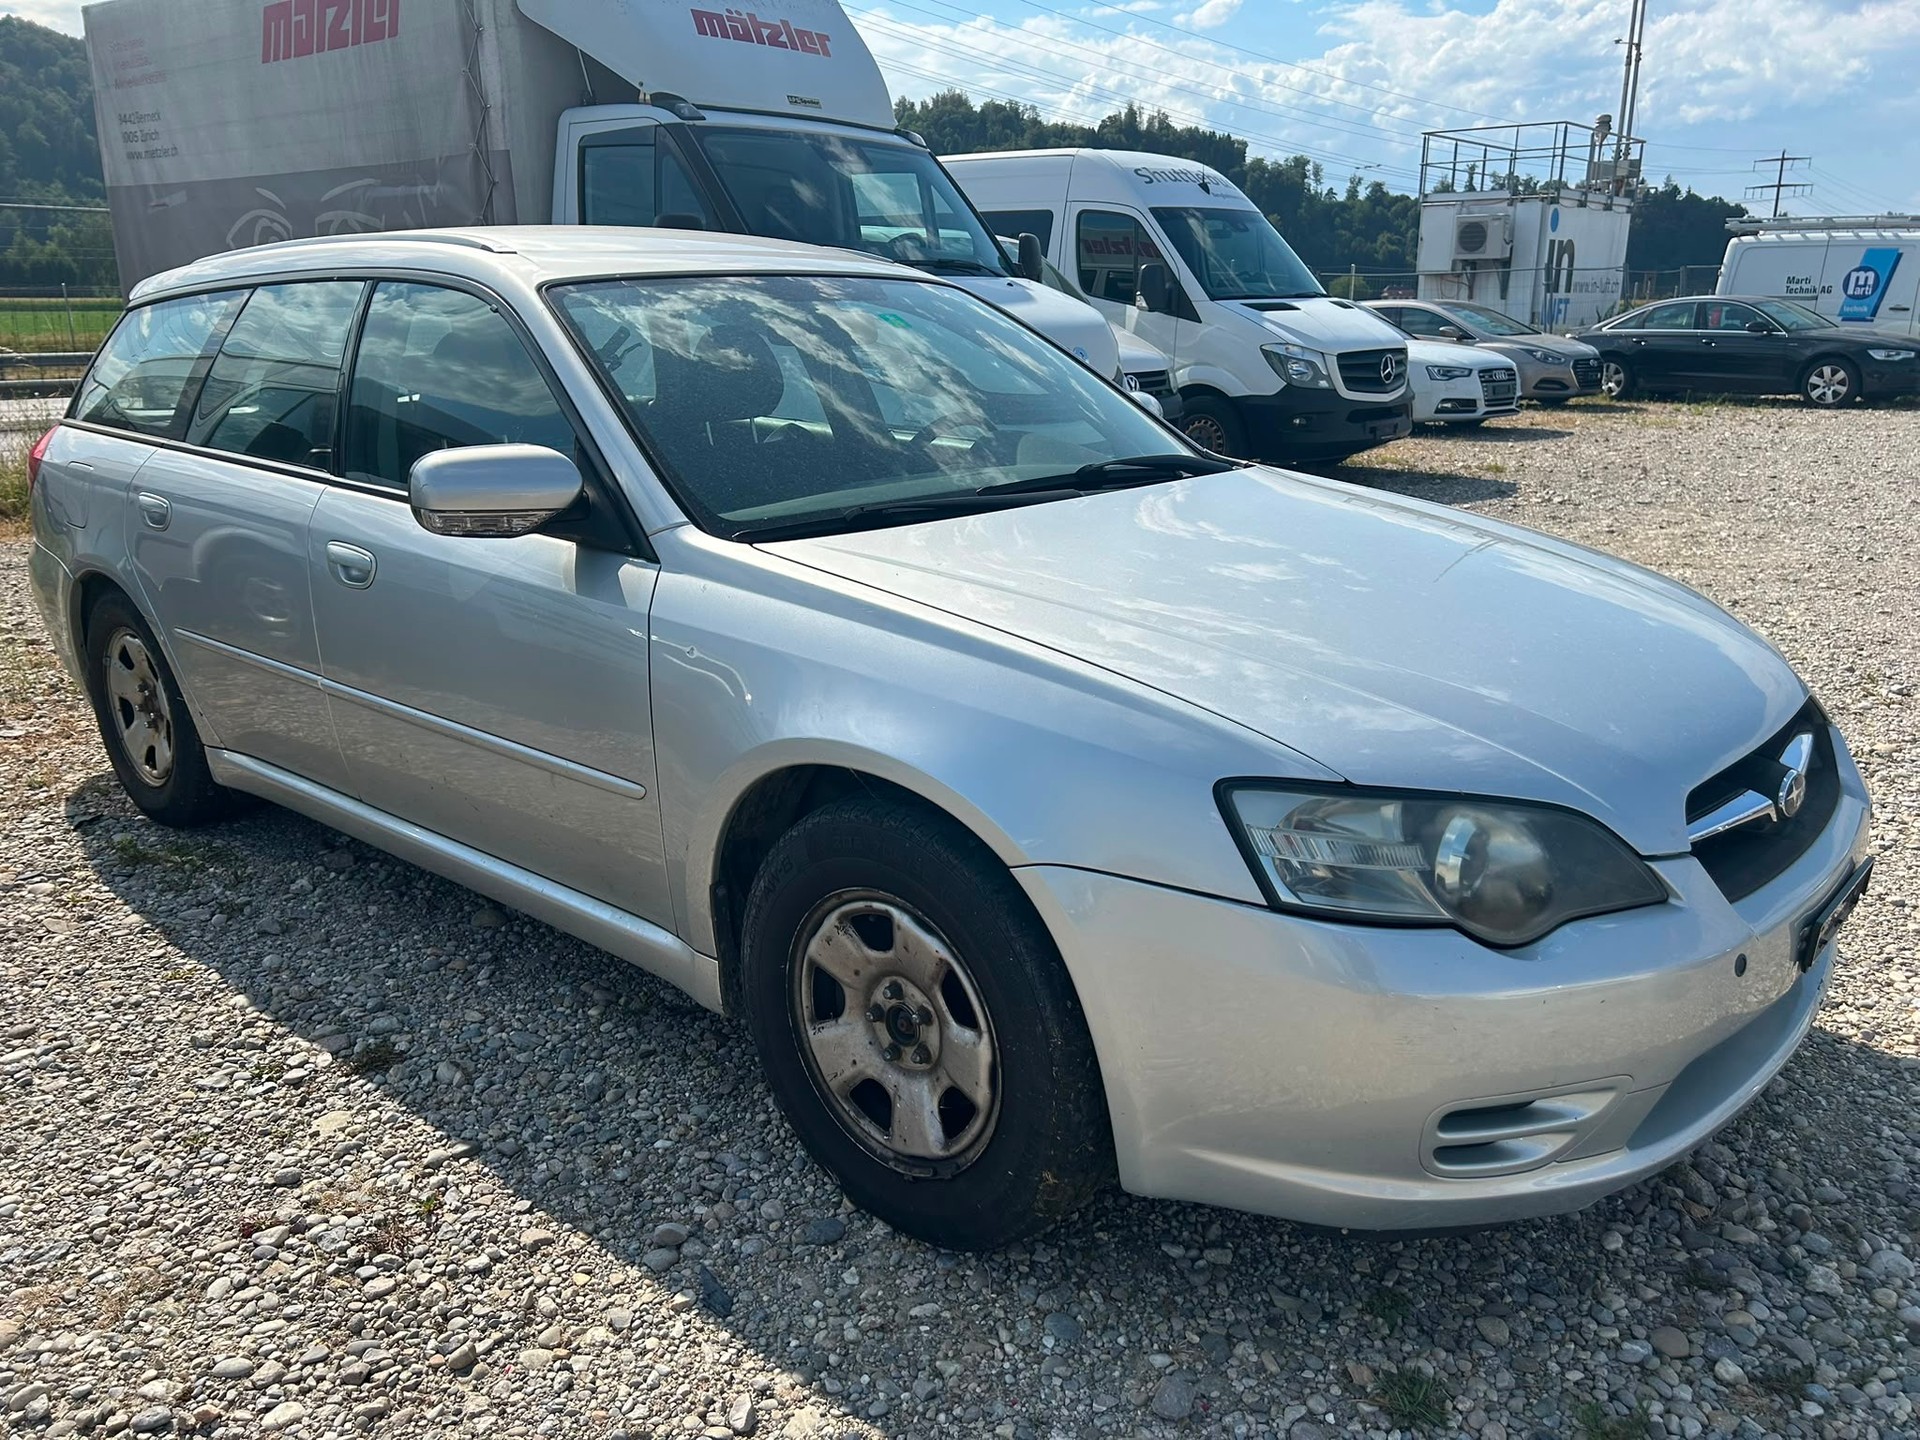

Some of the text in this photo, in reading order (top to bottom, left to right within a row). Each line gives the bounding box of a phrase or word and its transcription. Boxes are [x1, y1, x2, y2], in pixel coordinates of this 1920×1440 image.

[1786, 275, 1812, 285] Marti
[1785, 285, 1833, 294] Technik AG
